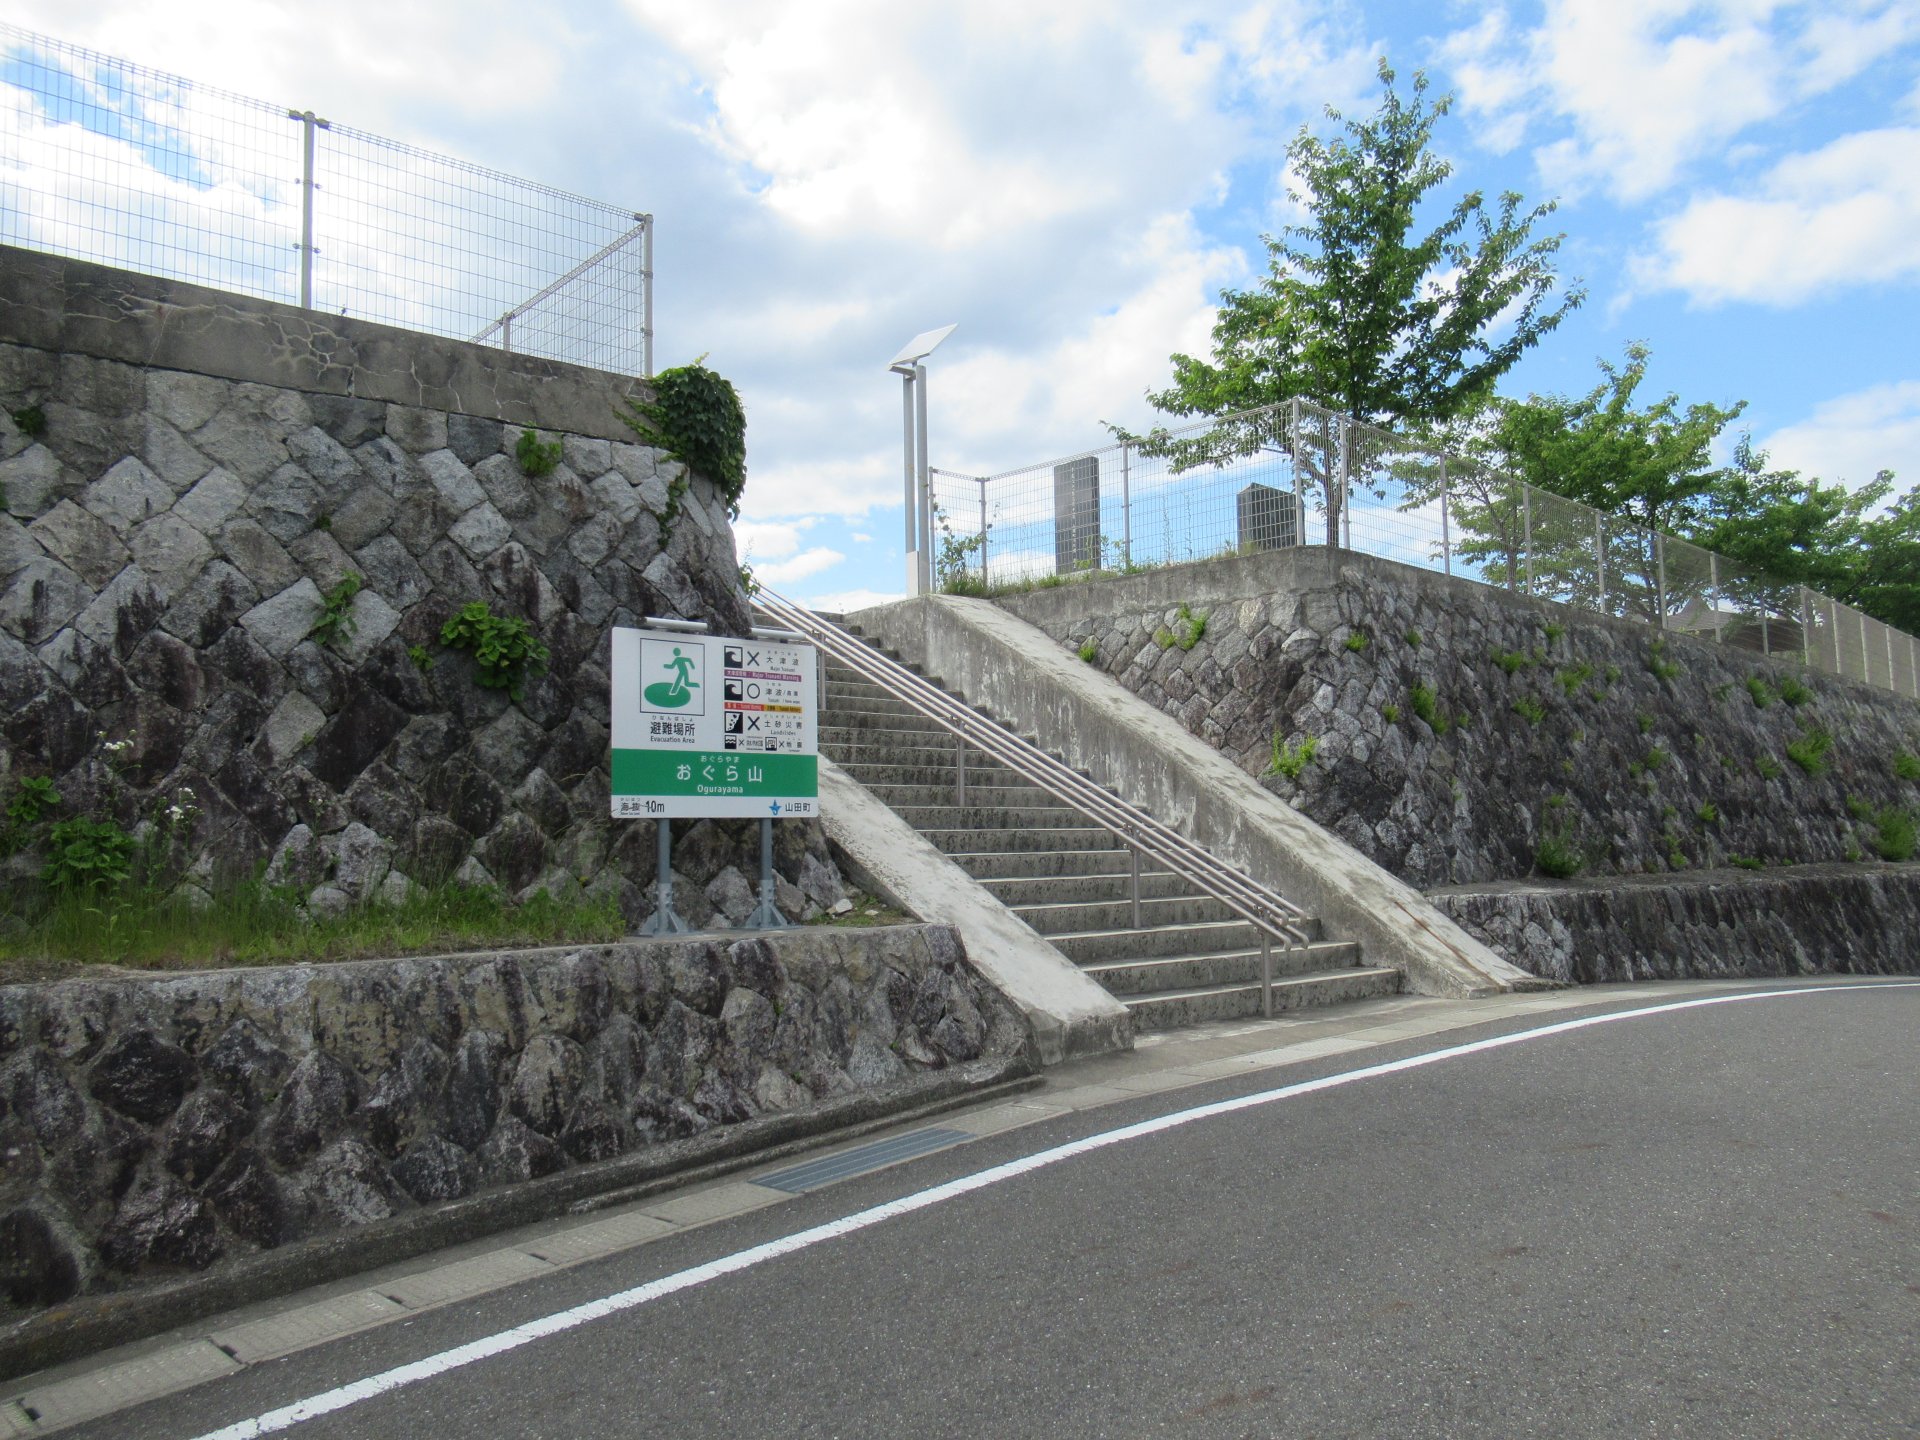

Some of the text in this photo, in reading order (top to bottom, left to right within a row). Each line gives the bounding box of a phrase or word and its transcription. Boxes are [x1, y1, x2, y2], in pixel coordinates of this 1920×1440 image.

[650, 721, 696, 736] 避難場所
[650, 735, 681, 743] Evacuation
[701, 755, 740, 764] おぐらやま
[676, 764, 763, 783] おぐら山
[697, 784, 744, 795] Ogurayama
[645, 800, 665, 813] 10m
[785, 801, 811, 812] 山田町
